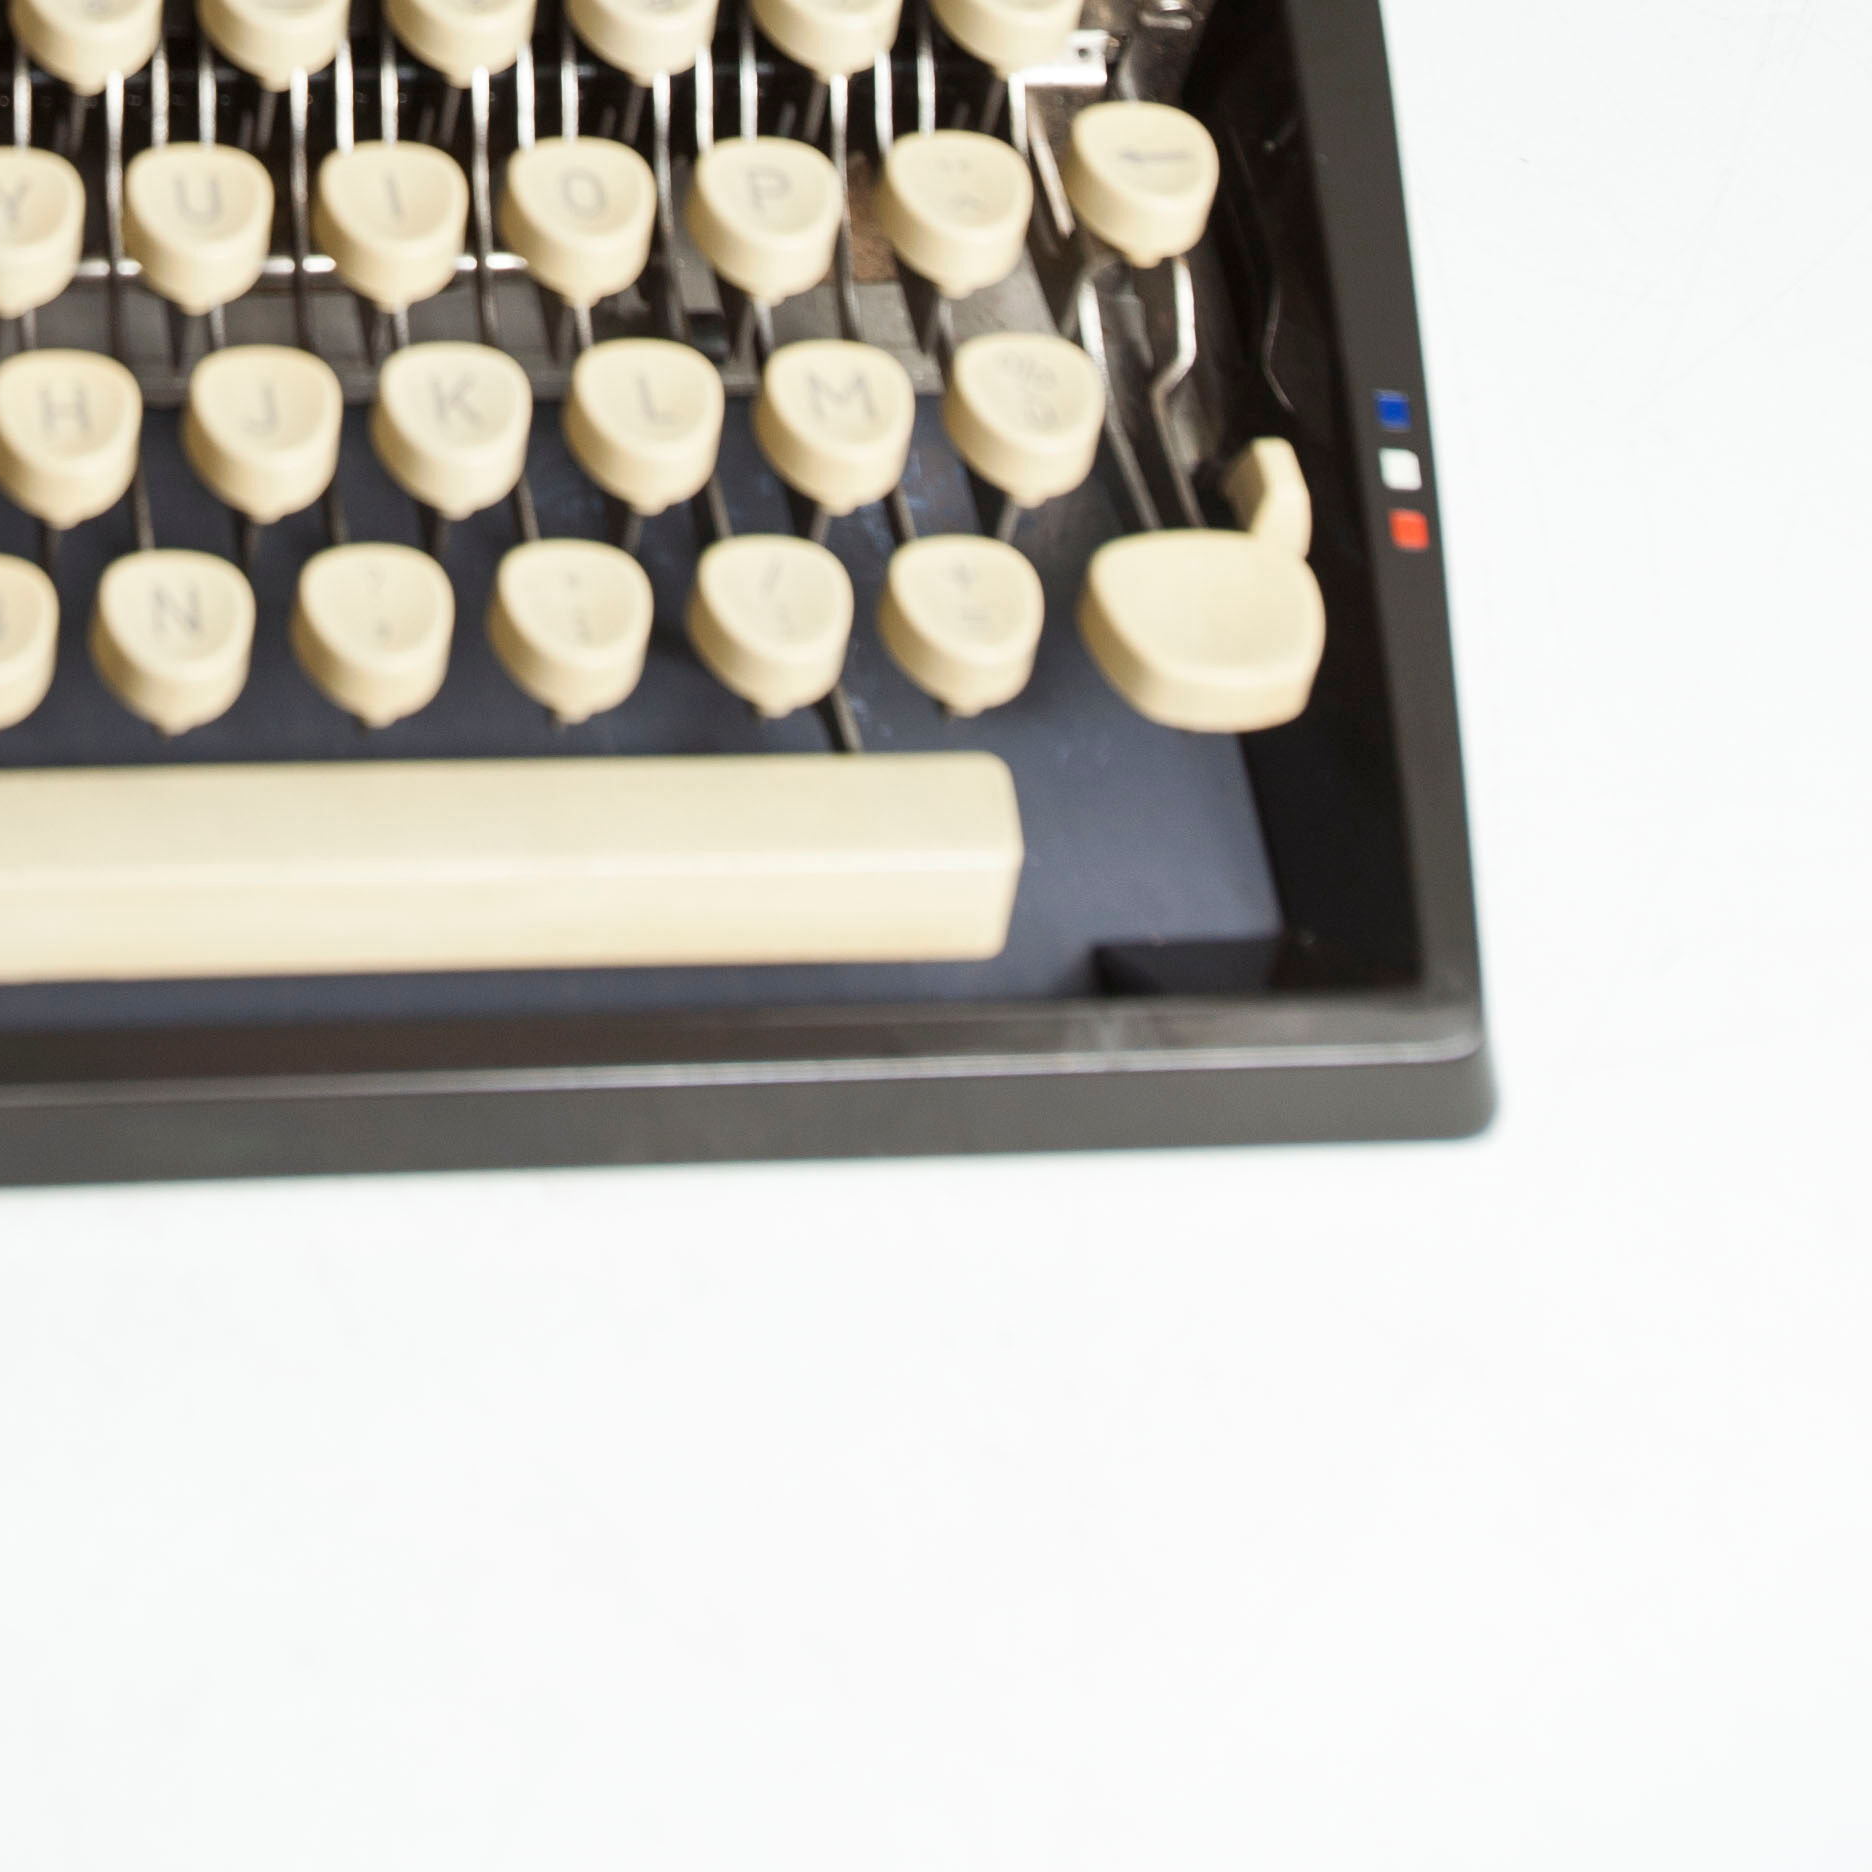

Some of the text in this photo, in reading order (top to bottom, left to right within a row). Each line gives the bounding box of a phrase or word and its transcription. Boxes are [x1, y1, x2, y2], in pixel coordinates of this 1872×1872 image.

[172, 174, 226, 224] U
[561, 170, 608, 218] O
[744, 168, 792, 214] P
[40, 386, 92, 436] H
[246, 383, 280, 436] J
[429, 374, 485, 426] K
[635, 370, 677, 425] L
[805, 369, 878, 424] M
[150, 583, 201, 637] N
